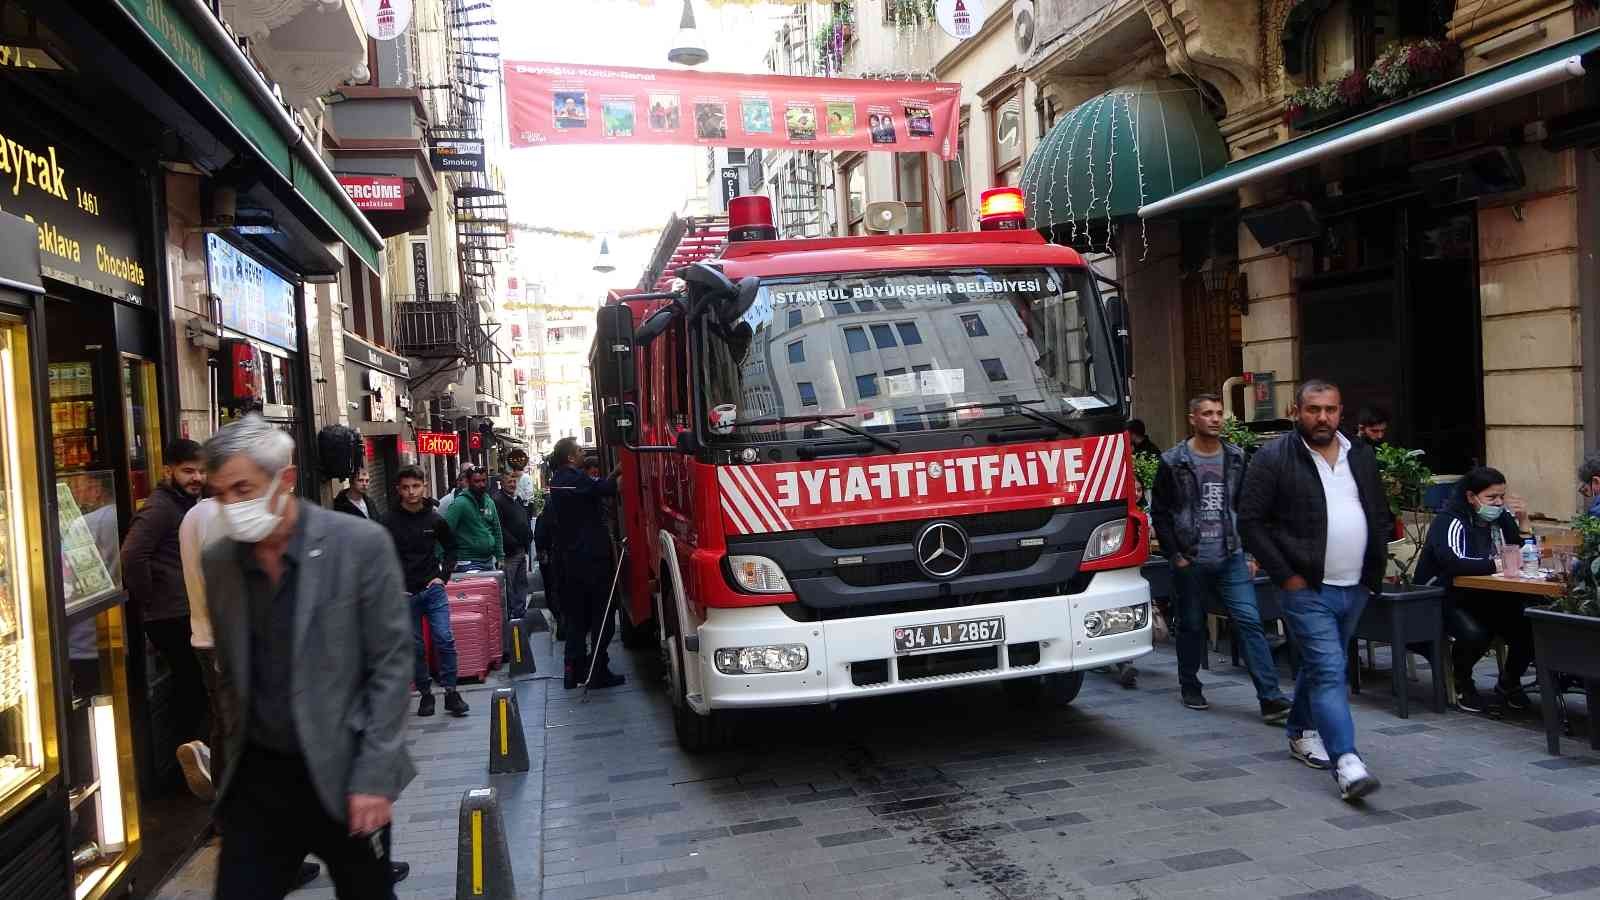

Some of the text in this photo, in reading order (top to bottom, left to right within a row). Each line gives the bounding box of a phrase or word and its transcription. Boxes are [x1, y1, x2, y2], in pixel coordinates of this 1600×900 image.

[442, 158, 478, 167] Smoking
[76, 187, 100, 216] 1461
[96, 243, 145, 286] Chocolate
[769, 277, 1041, 304] İSTANBUL BÜYÜKŞEHİR BELEDİYESİ
[421, 435, 454, 452] Tattoo
[904, 620, 1000, 648] 34 AJ 2867
